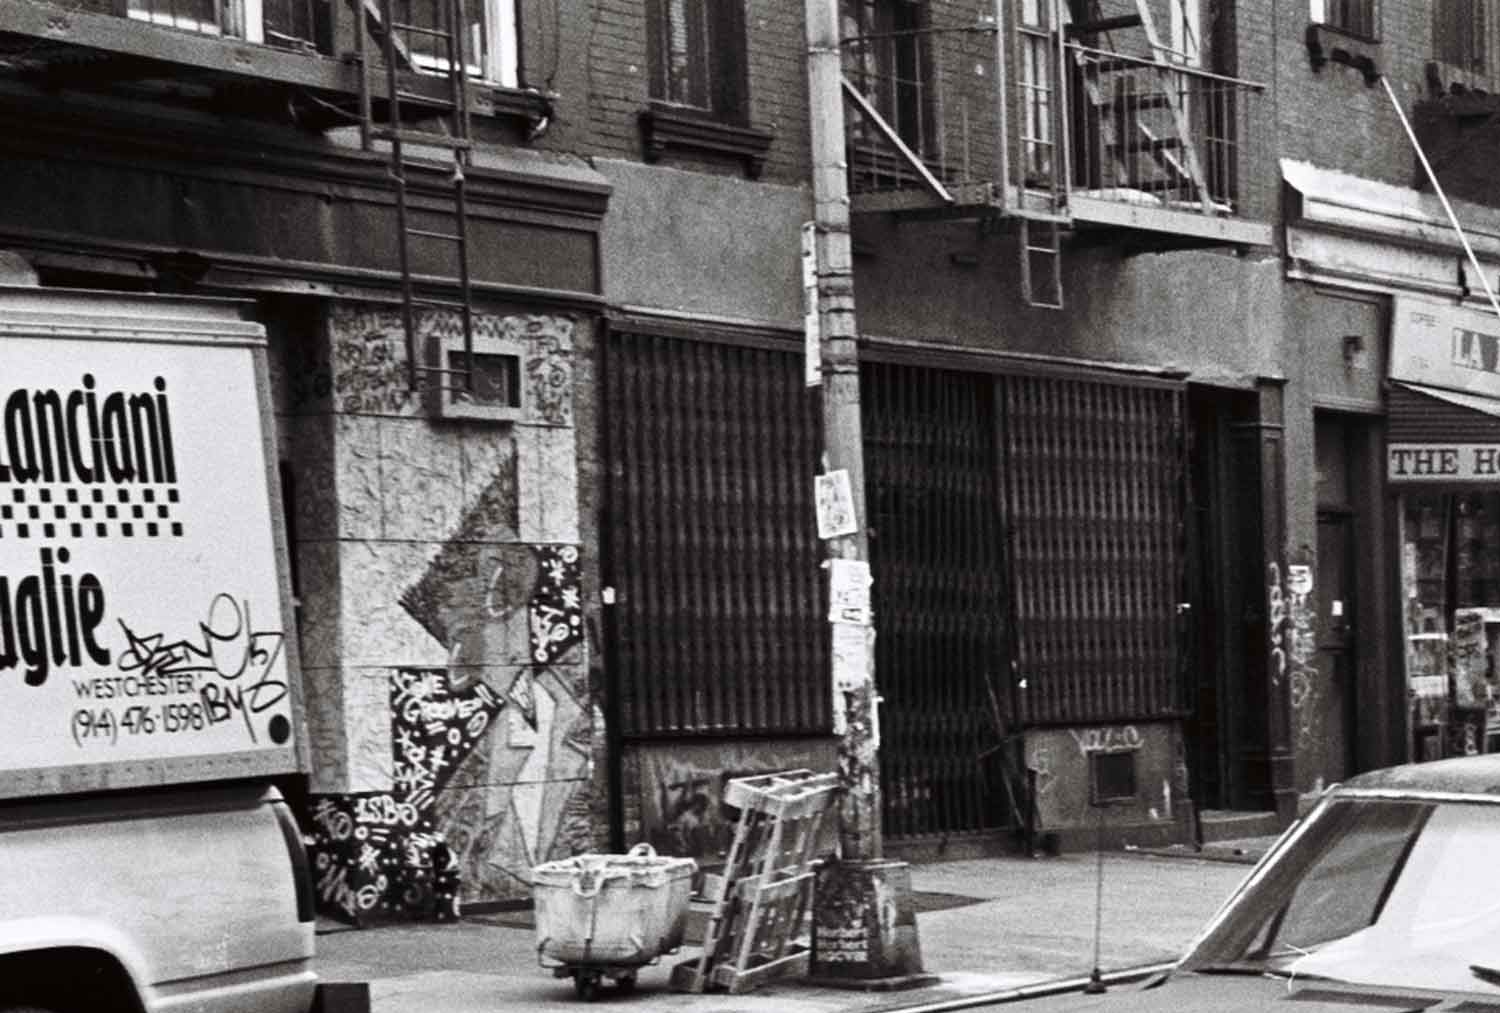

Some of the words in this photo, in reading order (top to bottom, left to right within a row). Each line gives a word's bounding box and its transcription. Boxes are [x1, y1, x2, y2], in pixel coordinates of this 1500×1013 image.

[0, 373, 177, 484] anciani
[1391, 448, 1459, 475] THE
[72, 672, 196, 699] WESTCHESTER
